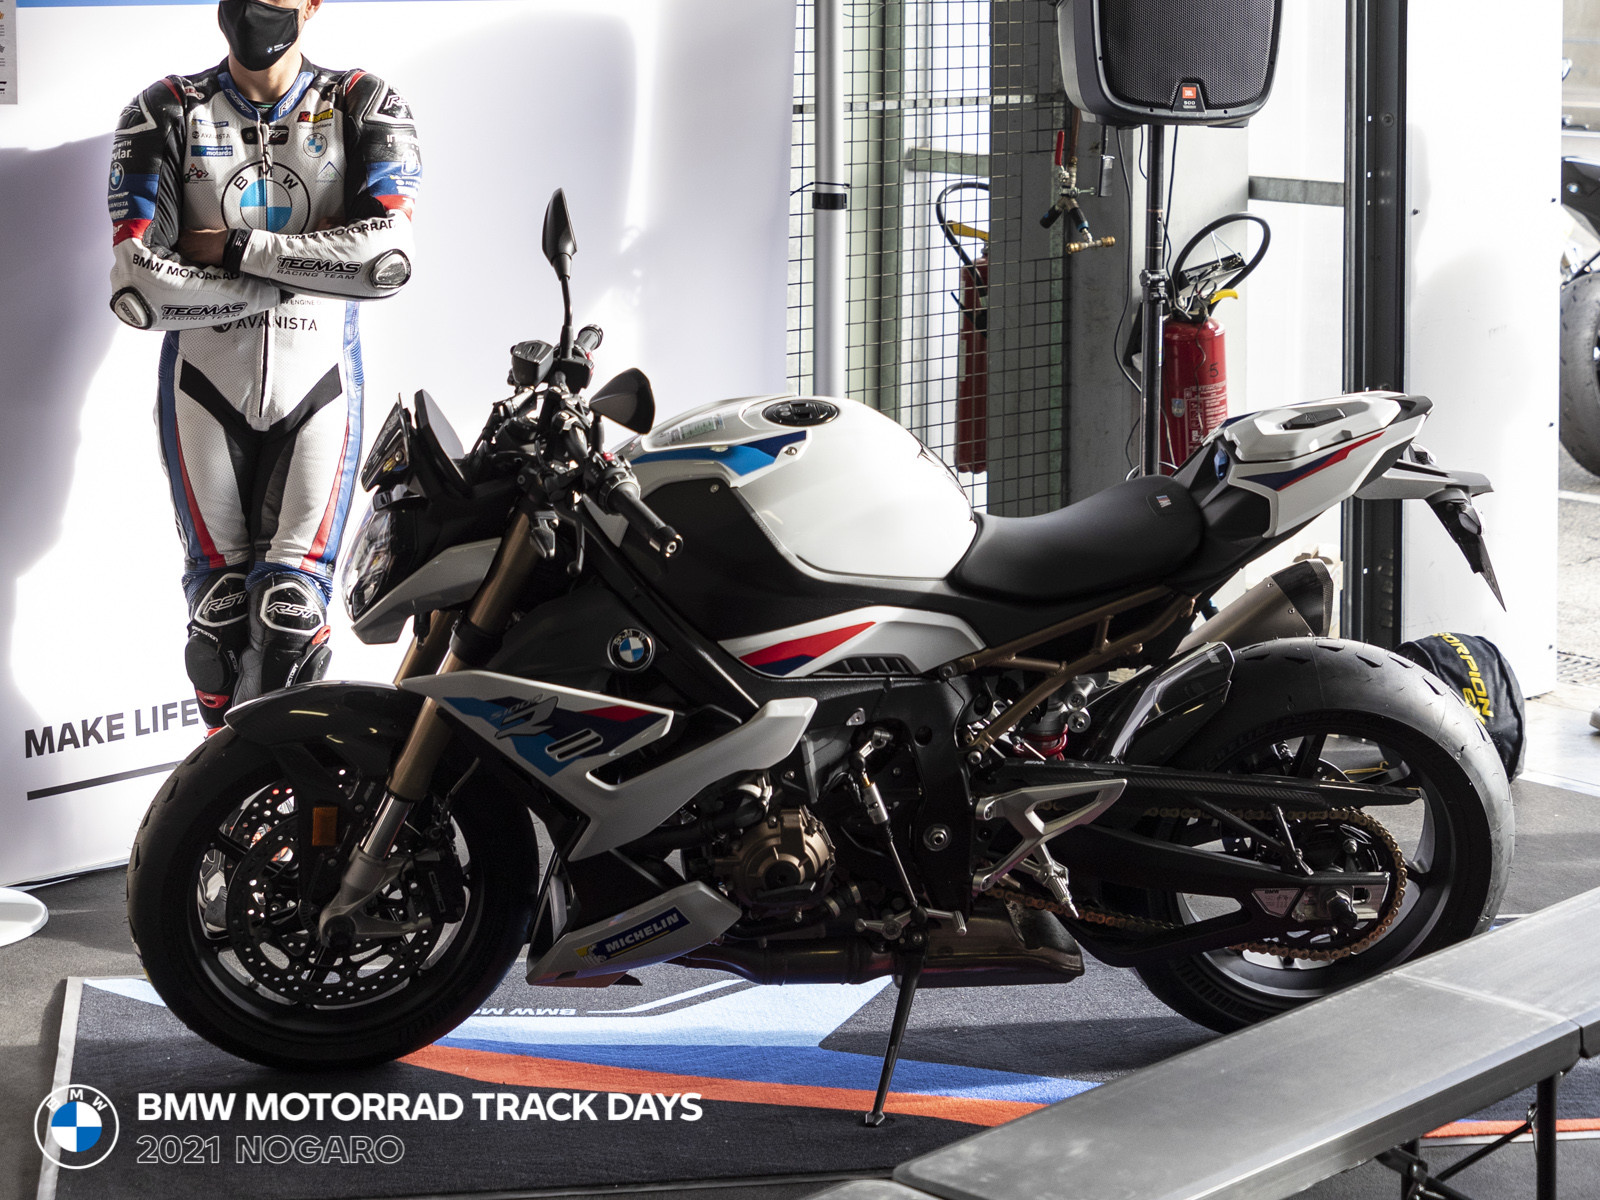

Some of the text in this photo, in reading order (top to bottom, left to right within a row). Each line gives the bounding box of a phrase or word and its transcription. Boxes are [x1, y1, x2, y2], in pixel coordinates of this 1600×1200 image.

[132, 253, 164, 272] BMW
[278, 256, 361, 274] TECMAS
[277, 269, 318, 277] RACING
[161, 303, 247, 316] TECMAS
[266, 601, 320, 619] RST
[25, 697, 199, 759] MAKE LIFE
[604, 911, 681, 953] MICHELIN
